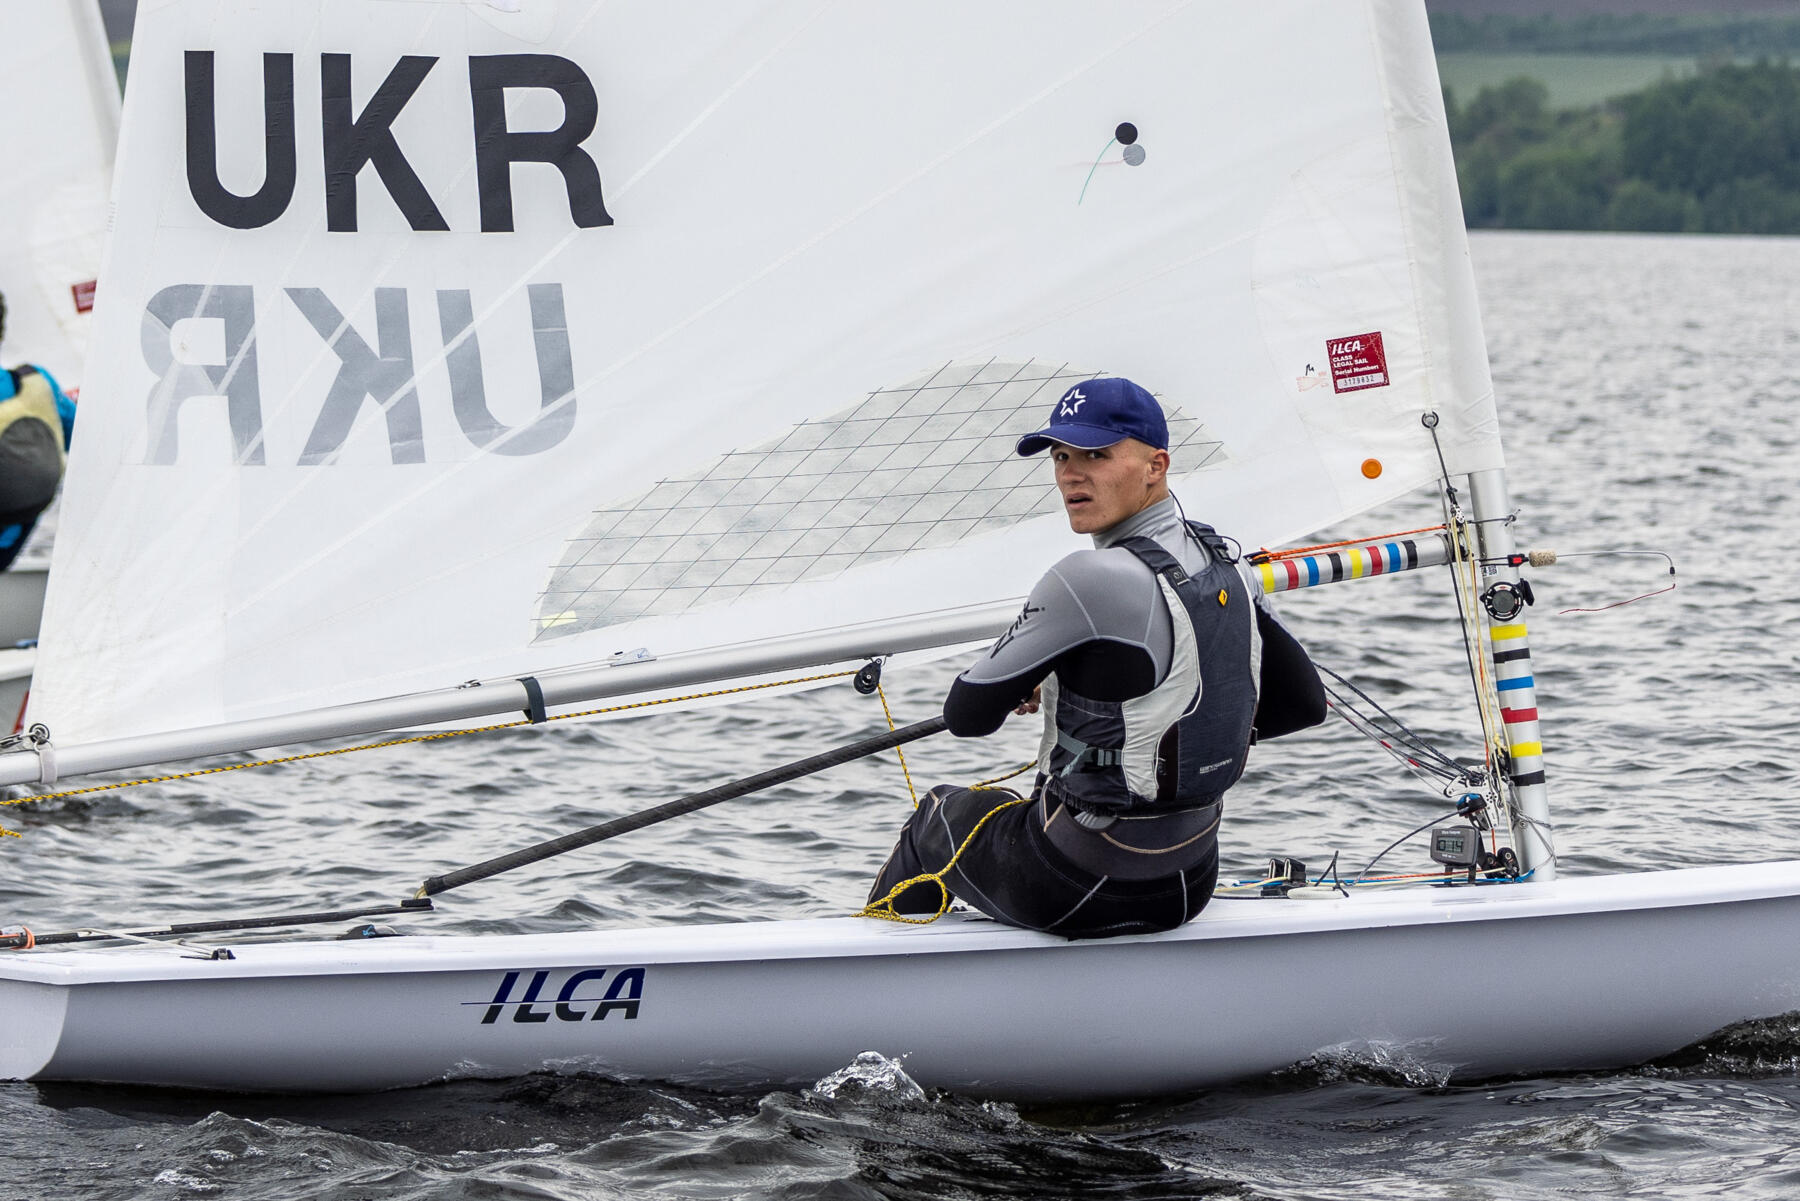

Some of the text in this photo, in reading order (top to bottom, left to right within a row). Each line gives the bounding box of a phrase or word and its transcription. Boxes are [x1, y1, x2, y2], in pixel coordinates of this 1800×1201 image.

[184, 50, 614, 232] UKR
[1332, 340, 1361, 355] ILCA
[1332, 355, 1353, 363] CLASS
[1334, 368, 1353, 376] Serial
[480, 967, 646, 1024] ILCA
